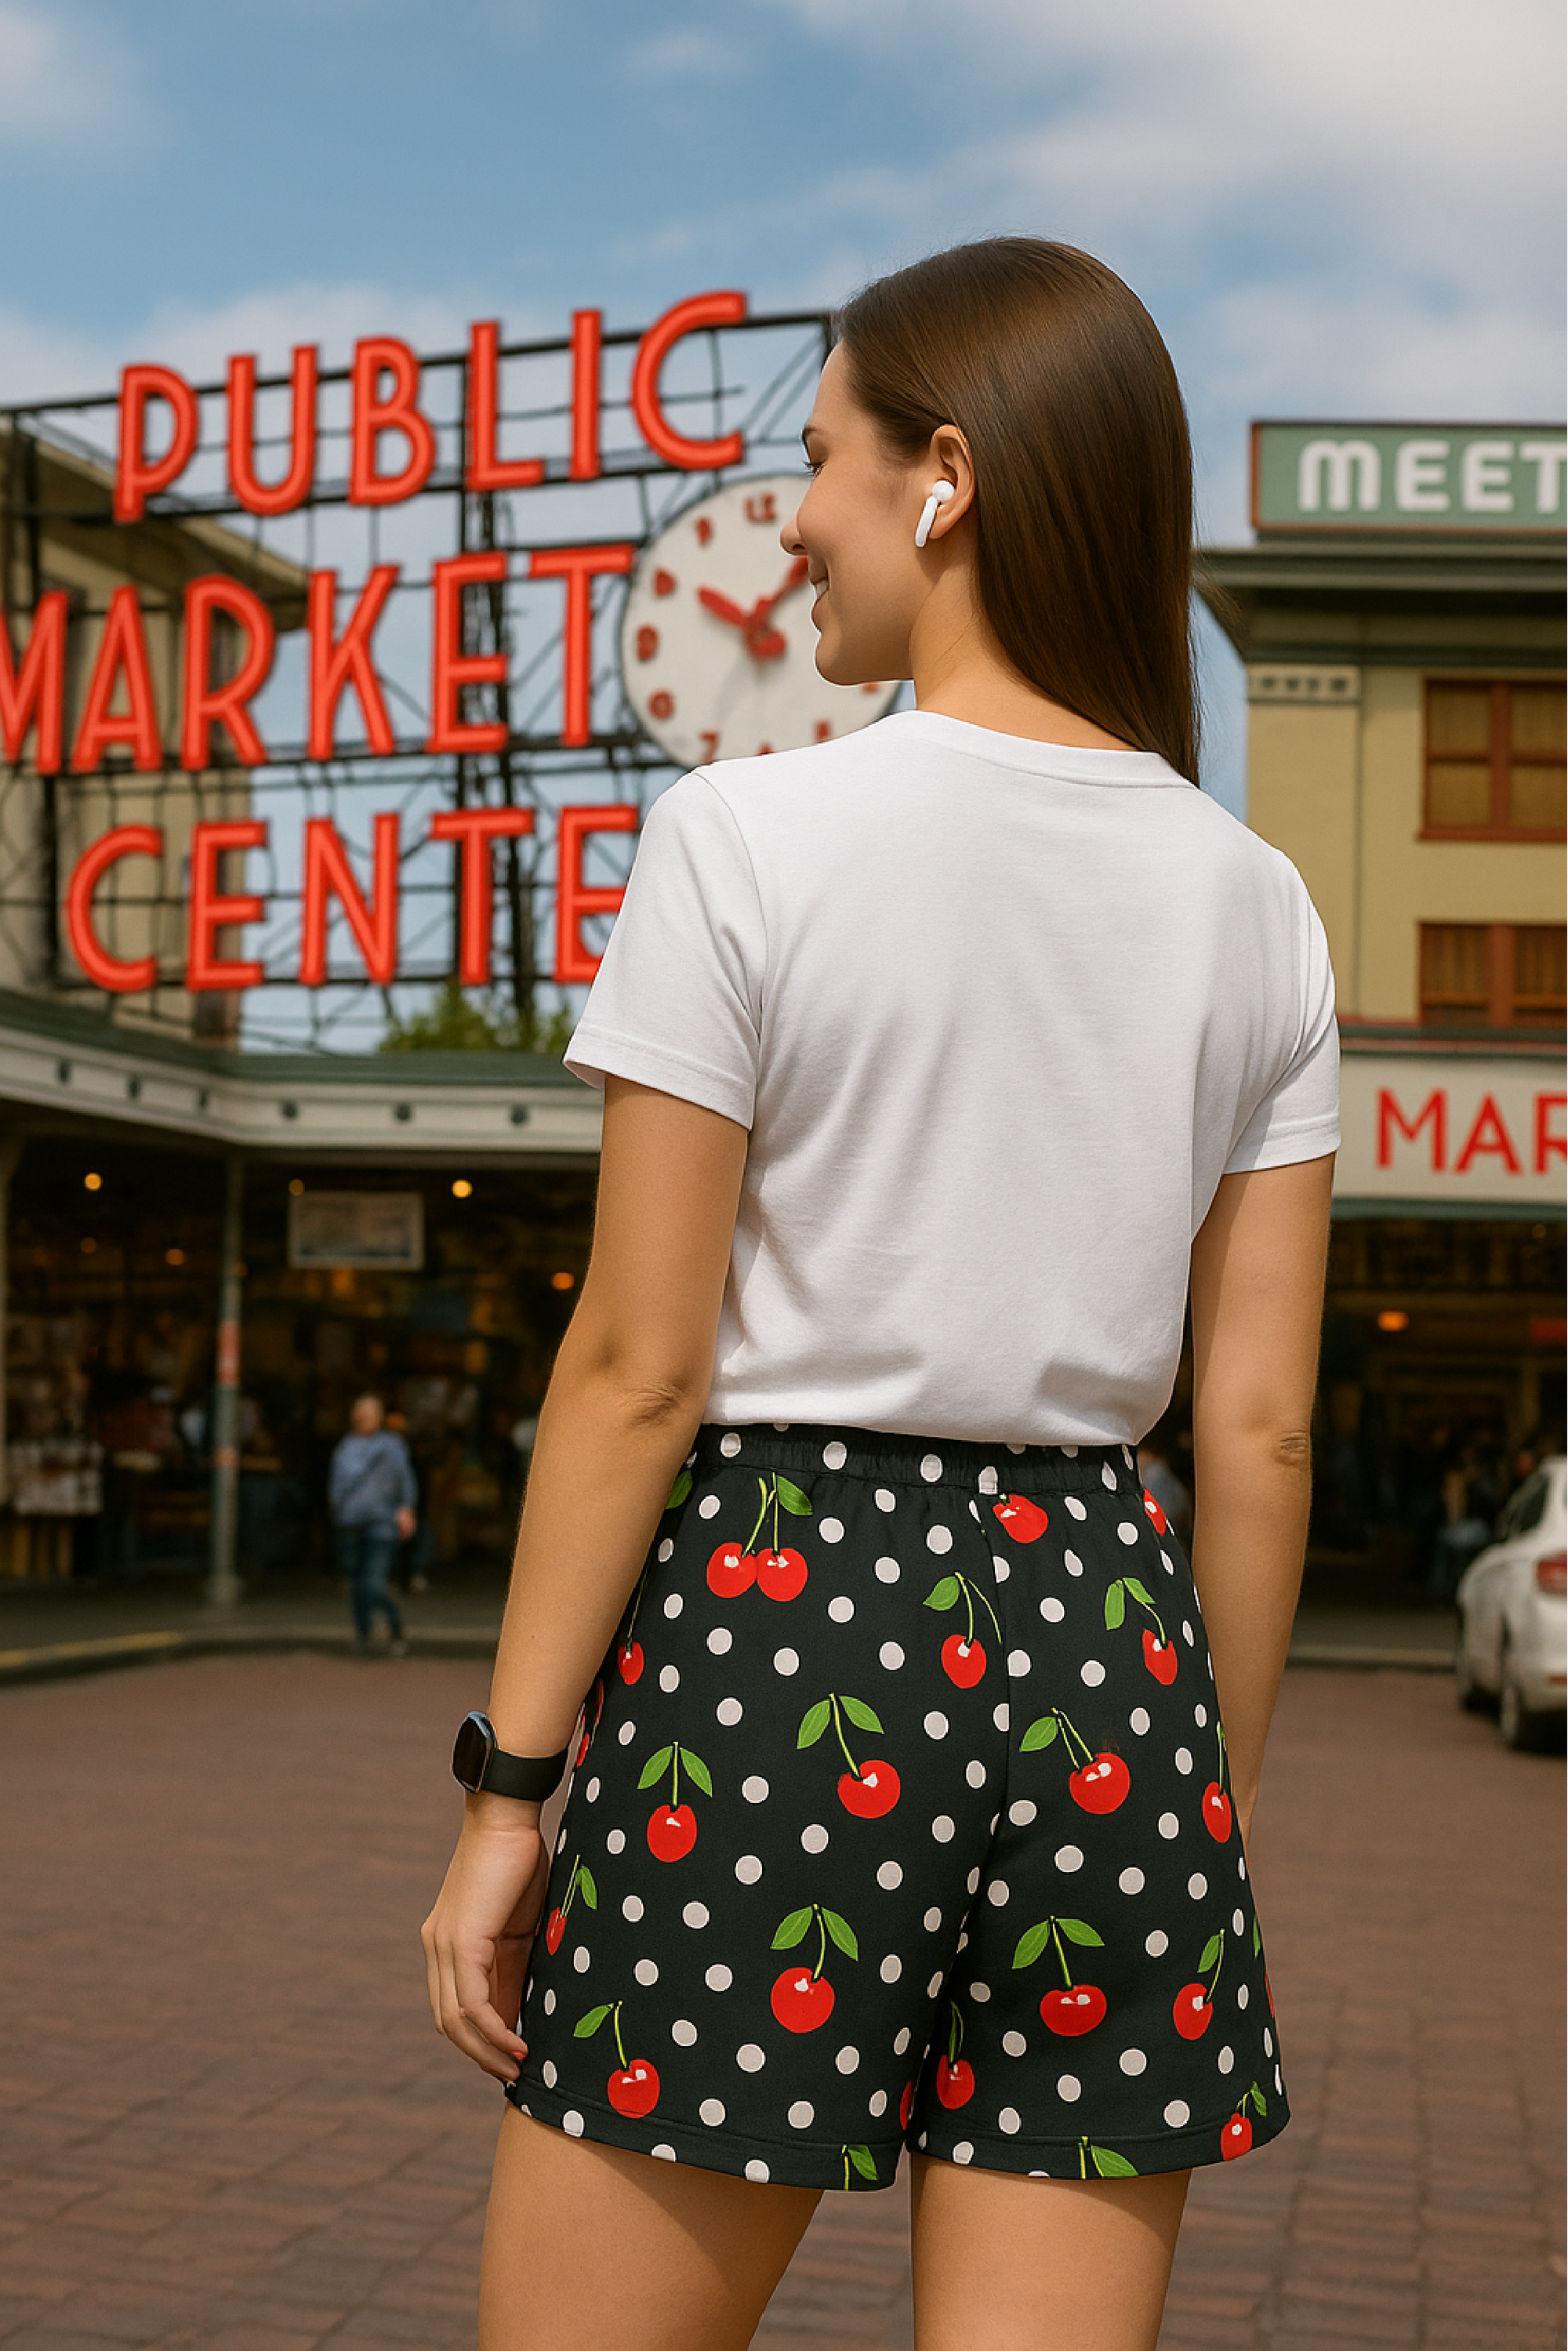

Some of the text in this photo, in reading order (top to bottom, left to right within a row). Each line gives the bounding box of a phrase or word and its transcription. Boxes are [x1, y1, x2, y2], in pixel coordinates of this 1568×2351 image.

[114, 289, 748, 524] PUBLIC
[1298, 438, 1568, 513] MEET
[0, 542, 634, 775] MARKET
